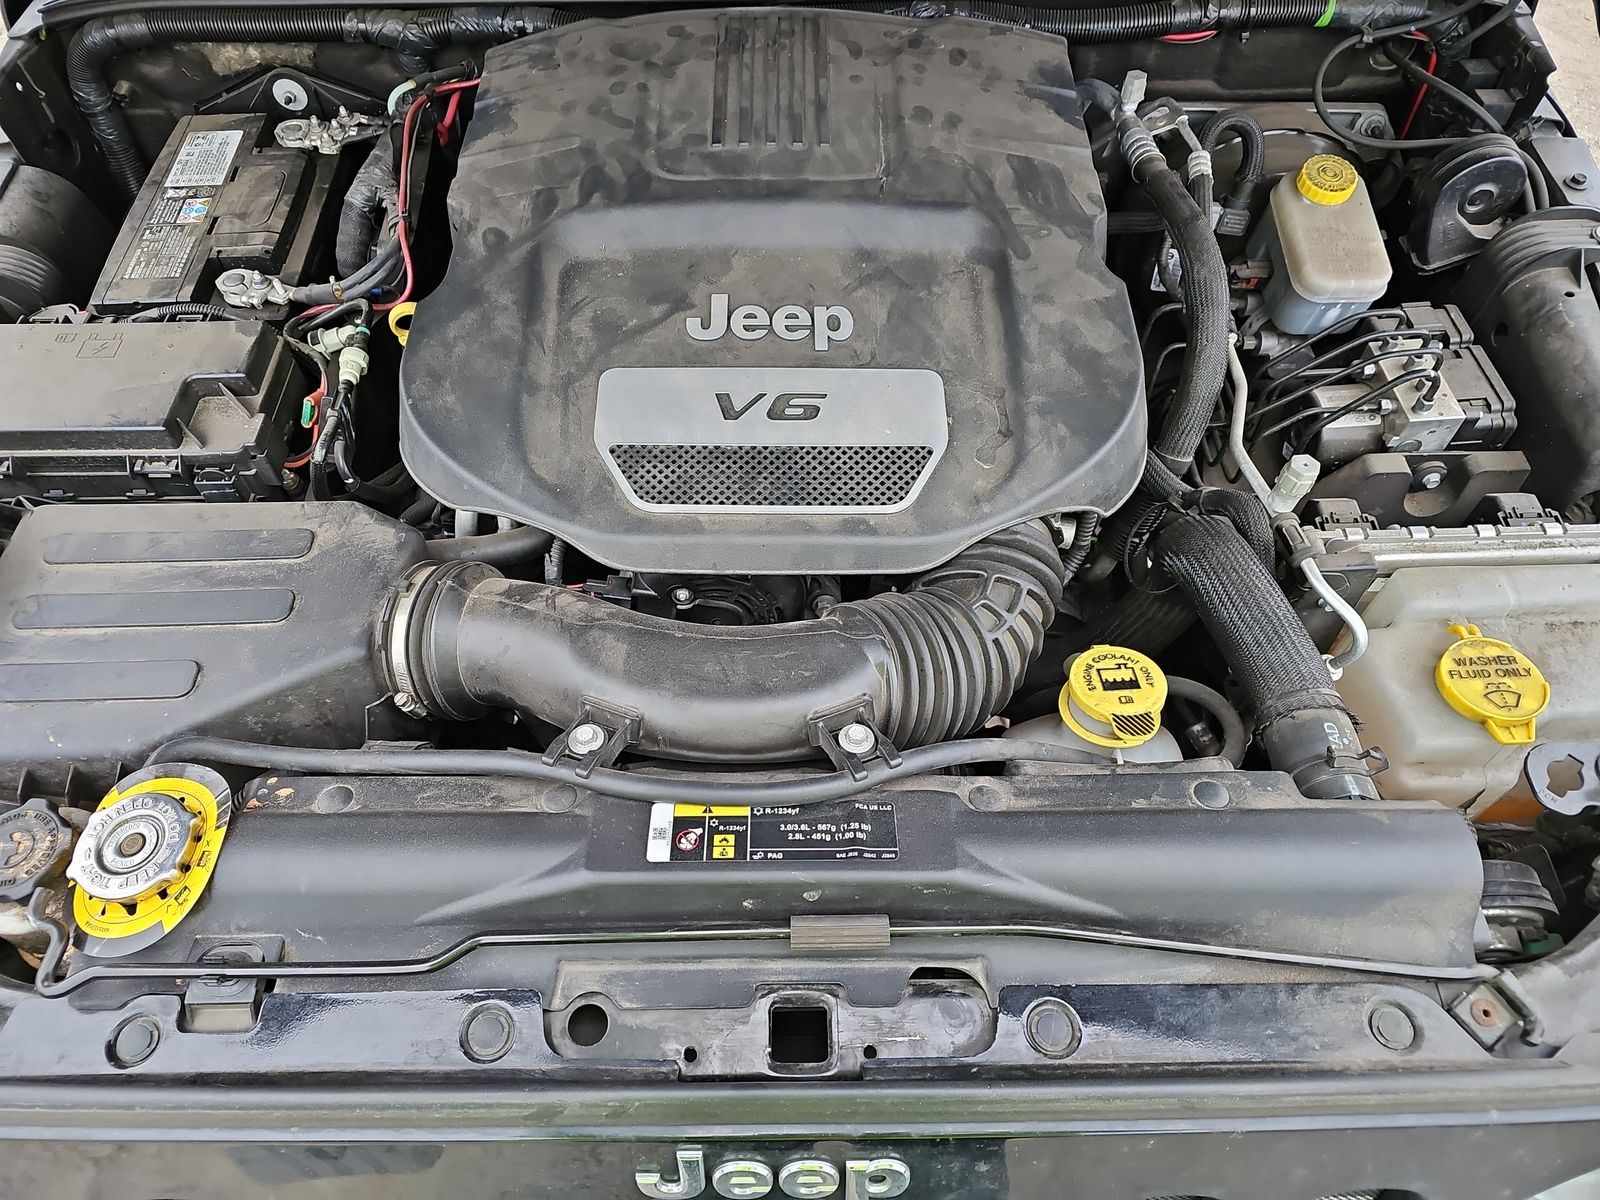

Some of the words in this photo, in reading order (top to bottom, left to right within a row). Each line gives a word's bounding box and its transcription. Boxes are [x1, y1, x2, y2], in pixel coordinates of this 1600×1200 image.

[686, 293, 854, 351] Jeep
[714, 392, 828, 421] V6
[1453, 655, 1518, 667] WASHER
[1083, 662, 1097, 692] ENGINE
[1092, 653, 1139, 665] COOLANT
[1140, 666, 1155, 688] ONLY
[1448, 669, 1492, 679] FLUID
[1495, 667, 1532, 678] ONLY
[765, 806, 799, 816] R-1234yf
[855, 803, 868, 811] FCA
[780, 823, 810, 832] 3.0/3.6L
[817, 823, 836, 833] 567g
[840, 822, 859, 832] (1.25
[860, 822, 872, 832] lb)
[788, 832, 806, 841] 2.8L
[812, 832, 831, 842] 451g
[835, 832, 854, 842] (1.00
[855, 831, 867, 842] lb)
[767, 851, 783, 860] PAG
[635, 1150, 911, 1200] Jeep
